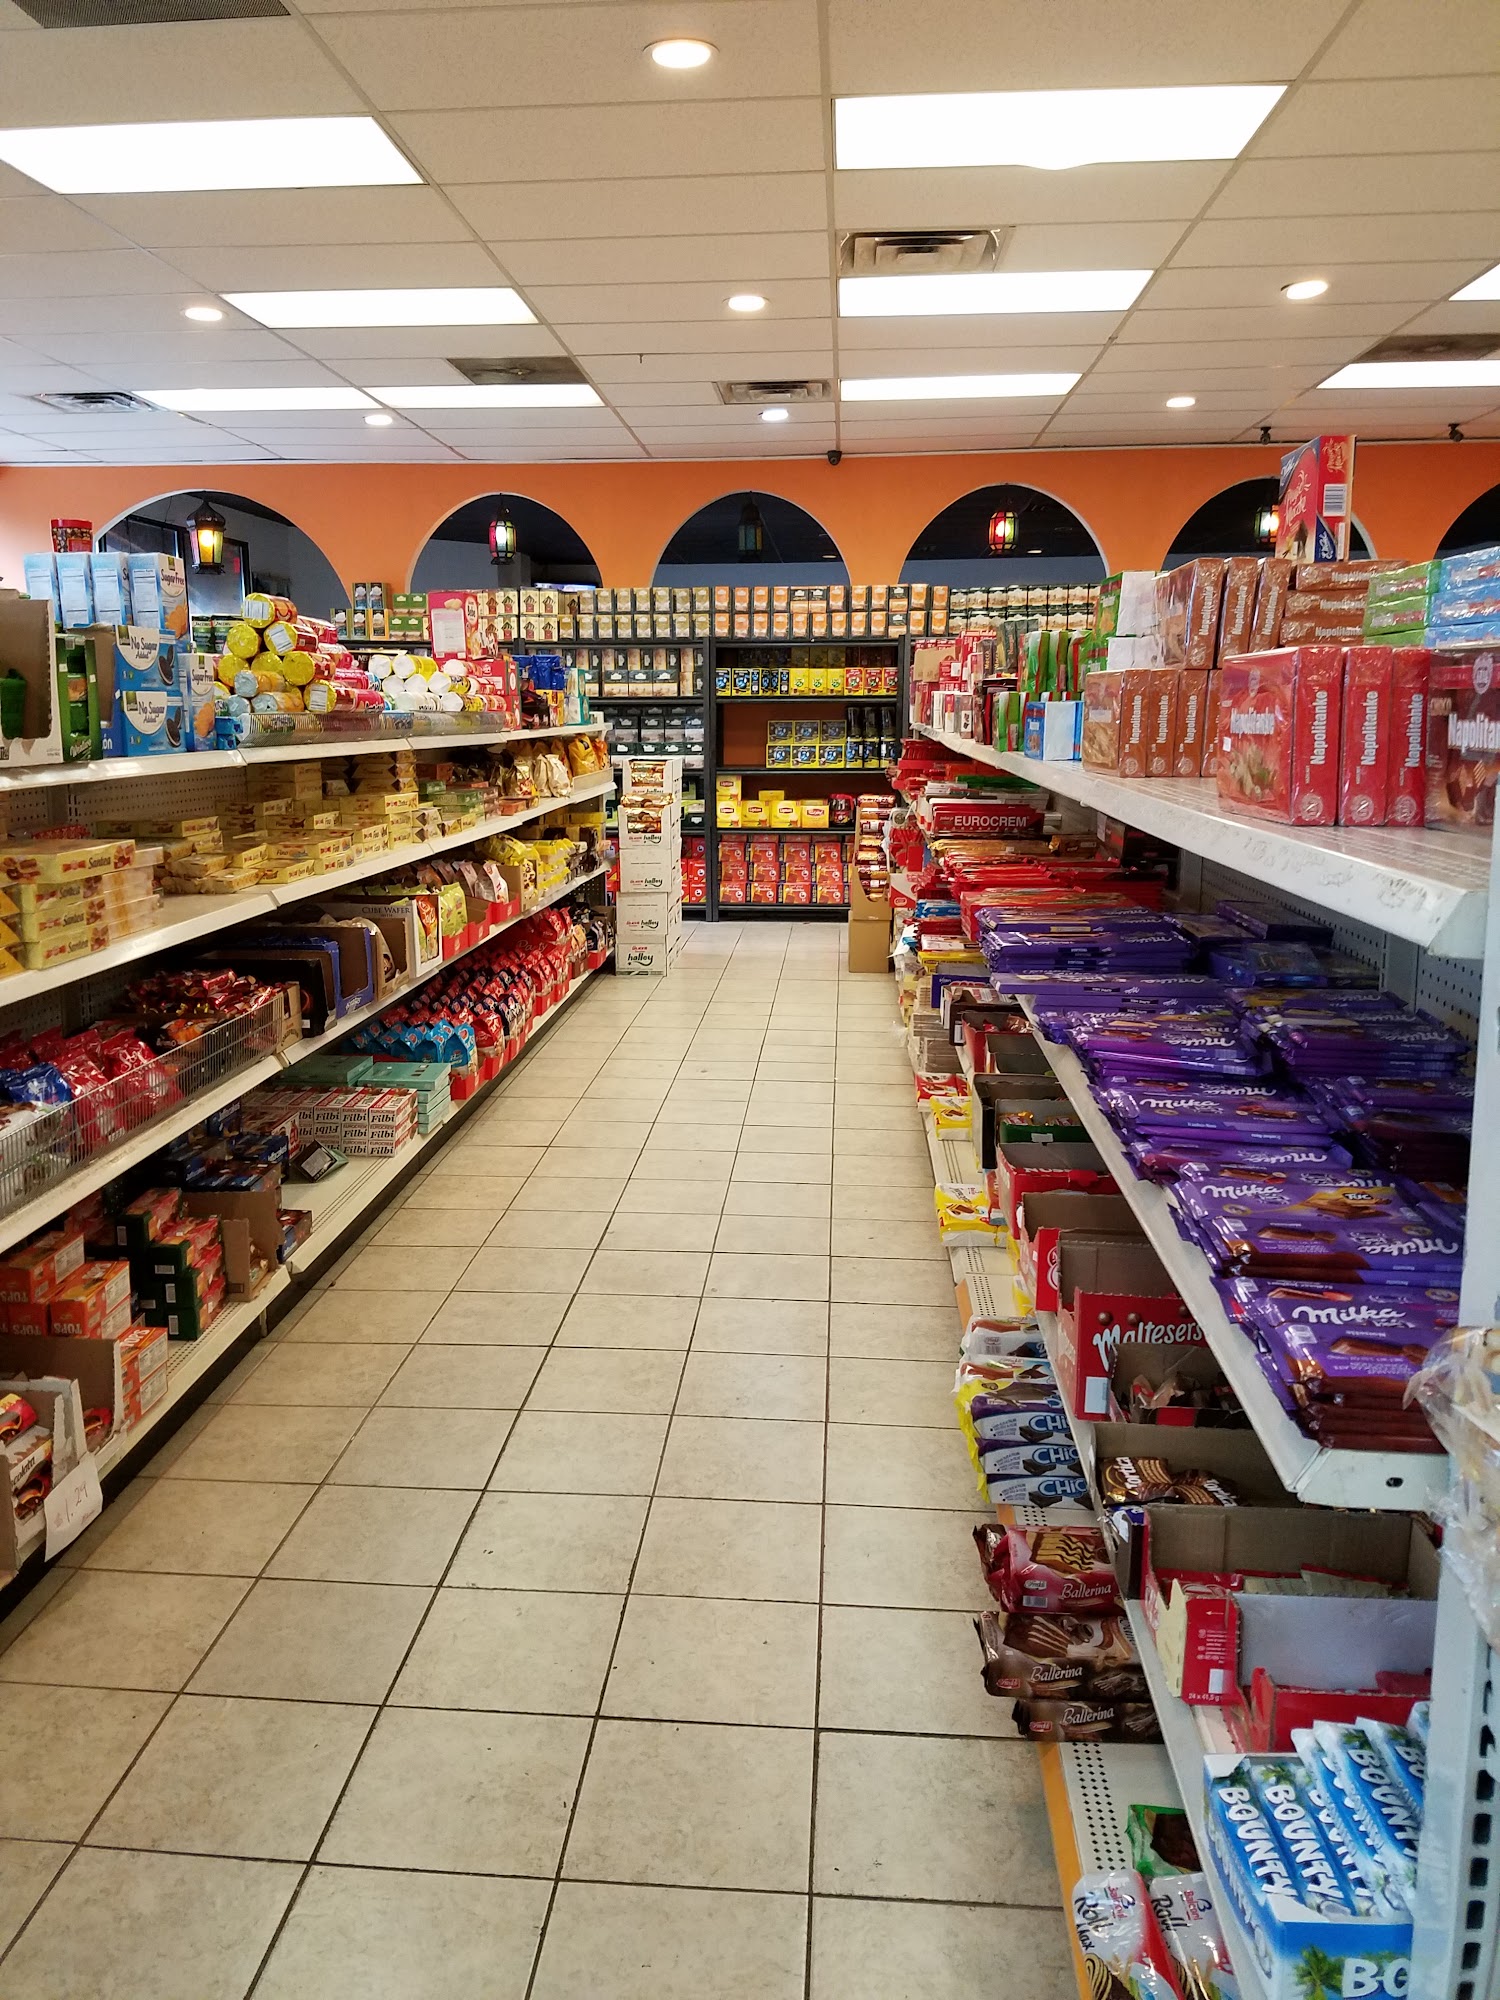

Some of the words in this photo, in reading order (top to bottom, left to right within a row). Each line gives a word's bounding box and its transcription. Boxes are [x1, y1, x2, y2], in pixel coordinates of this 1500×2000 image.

[1331, 572, 1378, 582] Napolitank
[1315, 626, 1362, 638] Napolitank
[1310, 690, 1328, 765] Napolitanke
[1360, 690, 1379, 765] Napolitanke
[1404, 693, 1424, 768] Napolitanke
[954, 815, 1028, 828] EUROCREM
[361, 906, 382, 915] CUBE
[384, 906, 411, 915] WAFER
[627, 953, 654, 967] halley
[1139, 1099, 1220, 1109] Milka
[316, 1112, 340, 1121] Filbi
[343, 1112, 367, 1122] Filbi
[371, 1114, 395, 1123] Filbi
[343, 1130, 367, 1138] Filbi
[370, 1130, 394, 1139] Filbi
[343, 1146, 367, 1154] Filbi
[370, 1146, 394, 1154] Filbi
[1201, 1184, 1284, 1199] Milka
[1357, 1238, 1459, 1257] Milka
[1292, 1305, 1407, 1325] Milka
[53, 1323, 82, 1334] TOPS
[120, 1329, 150, 1348] TOPS
[1093, 1321, 1203, 1372] Maltesers
[1113, 1456, 1142, 1489] Tortica
[1061, 1581, 1112, 1600] Ballerina
[1030, 1664, 1083, 1683] Ballerina
[1062, 1705, 1115, 1725] Ballerina
[1218, 1786, 1298, 1897] BOUNTY
[1265, 1784, 1344, 1898] BOUNTY
[1183, 1890, 1203, 1921] Balconi
